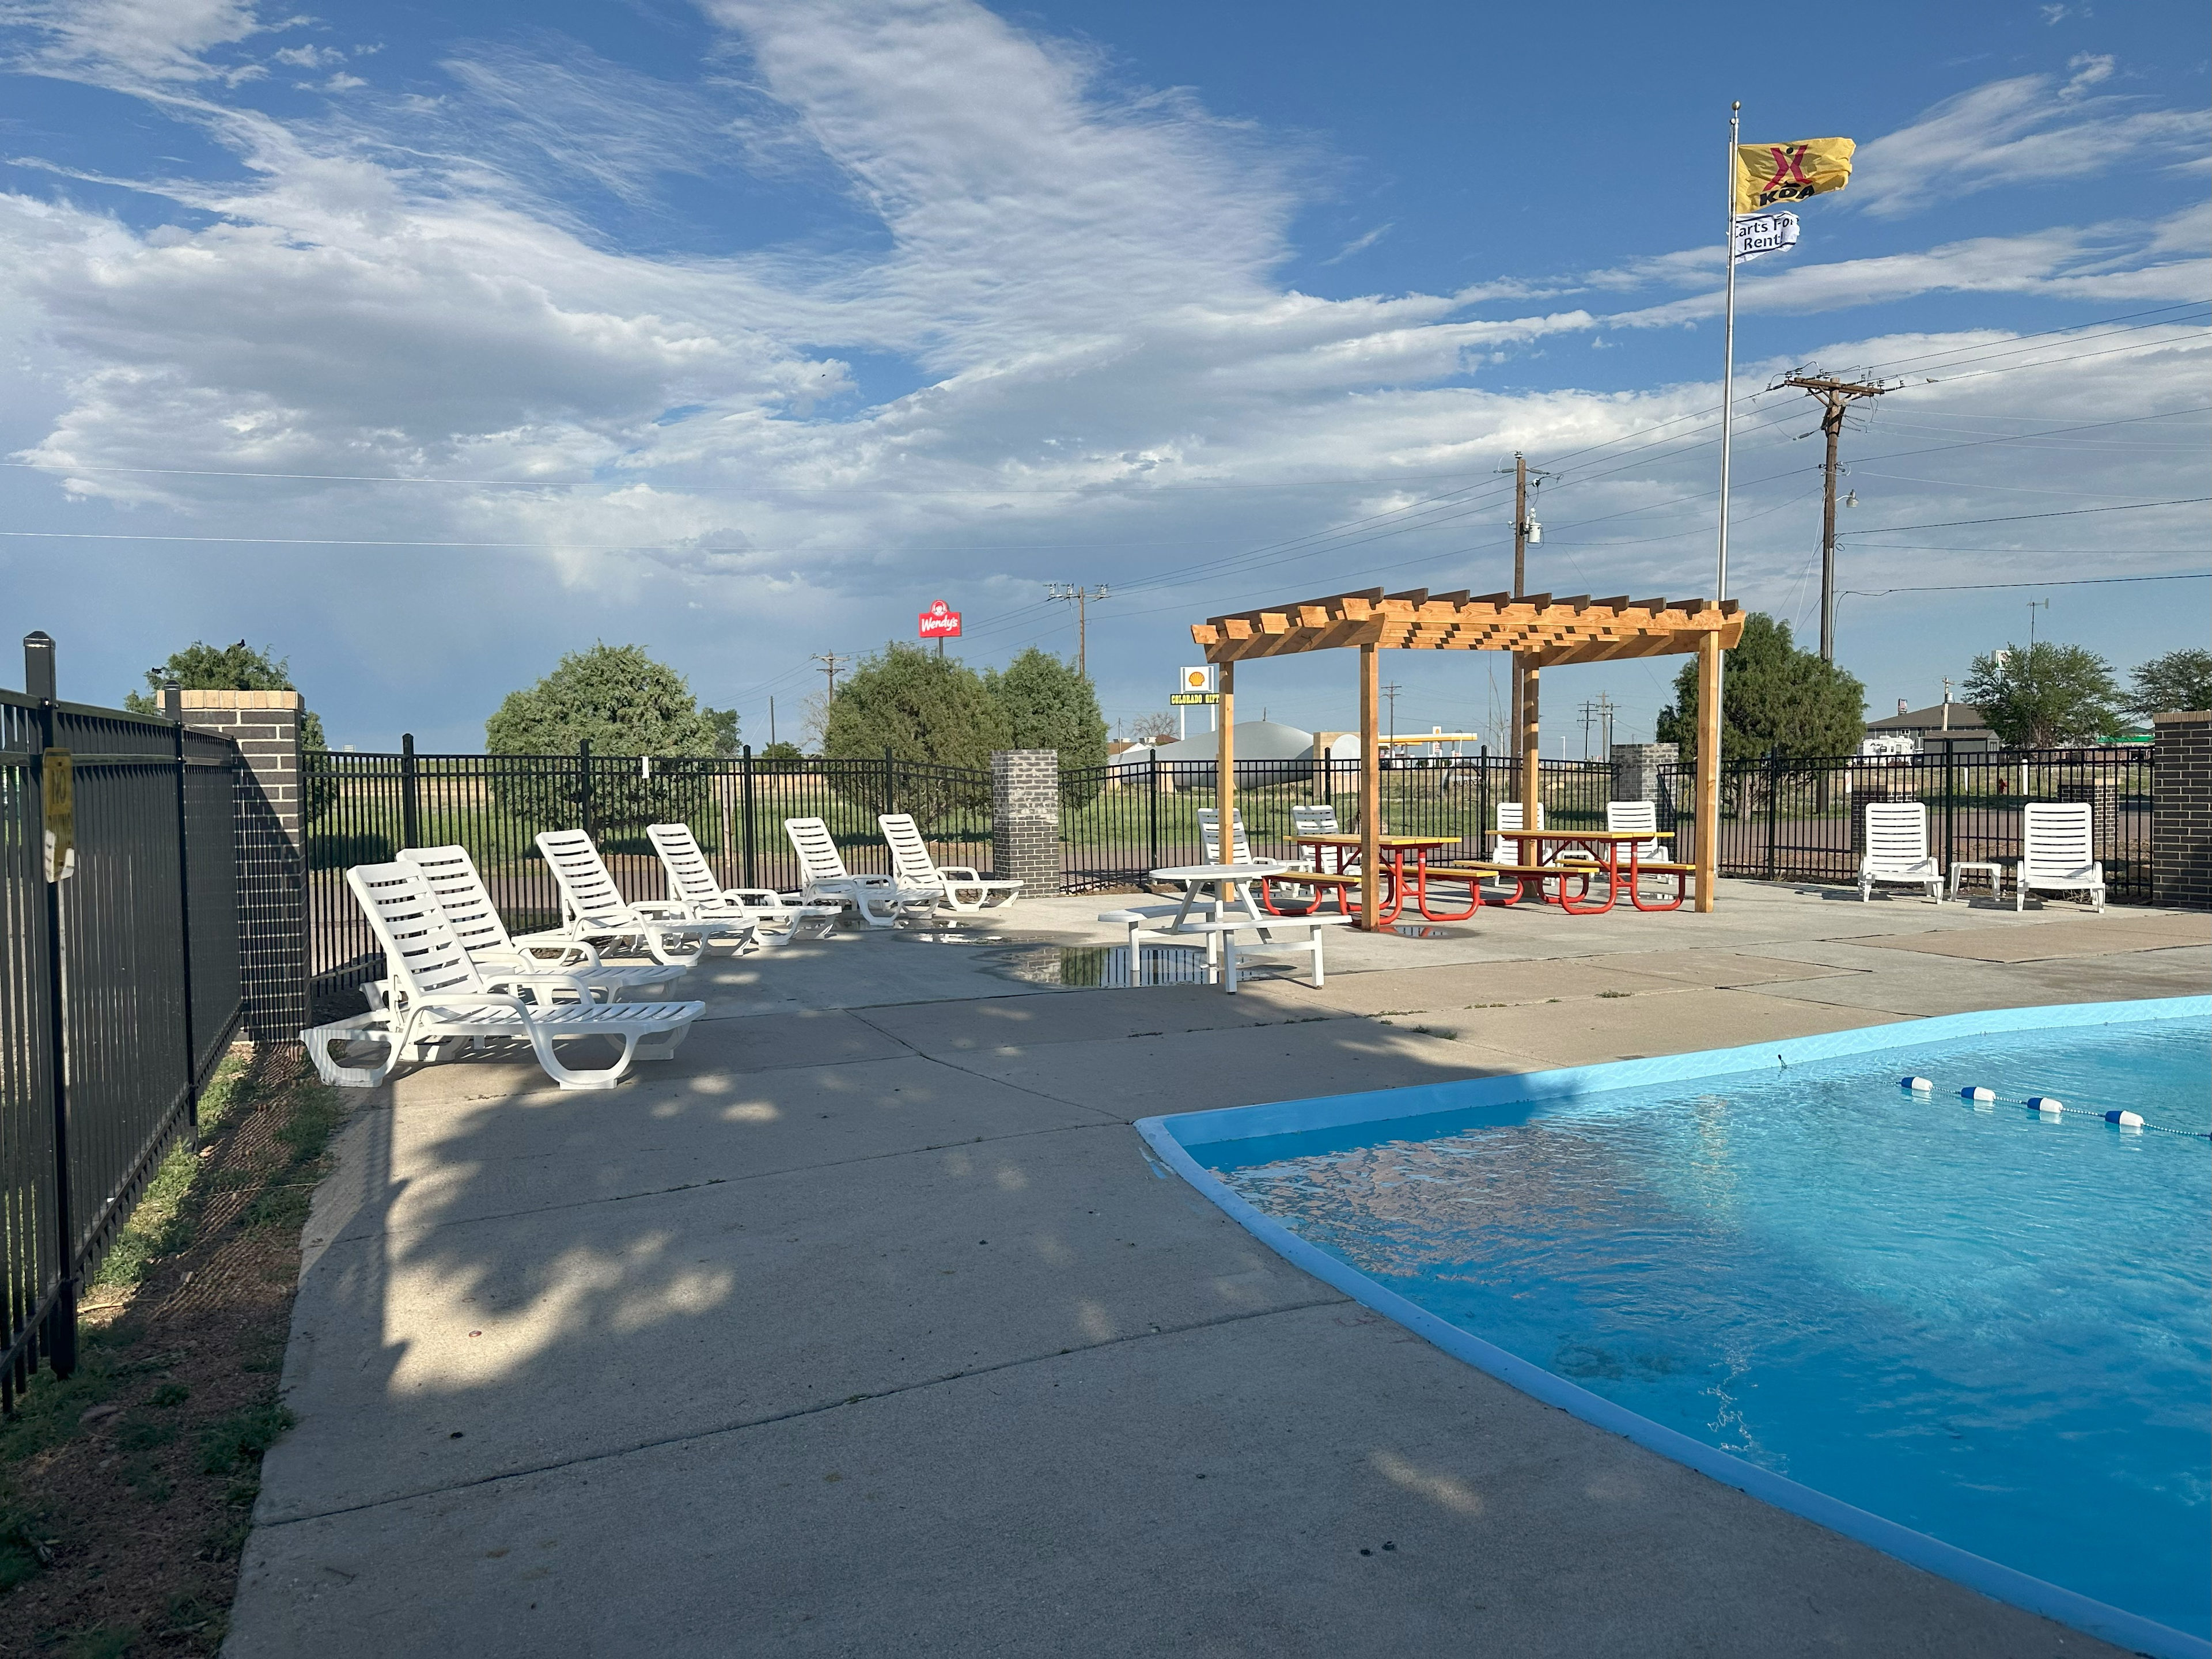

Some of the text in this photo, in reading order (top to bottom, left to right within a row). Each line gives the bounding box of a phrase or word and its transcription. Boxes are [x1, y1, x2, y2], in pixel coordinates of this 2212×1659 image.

[1759, 184, 1815, 207] KOA
[921, 614, 959, 632] Wendy's
[1171, 694, 1203, 704] COLORADO
[52, 769, 67, 804] NO
